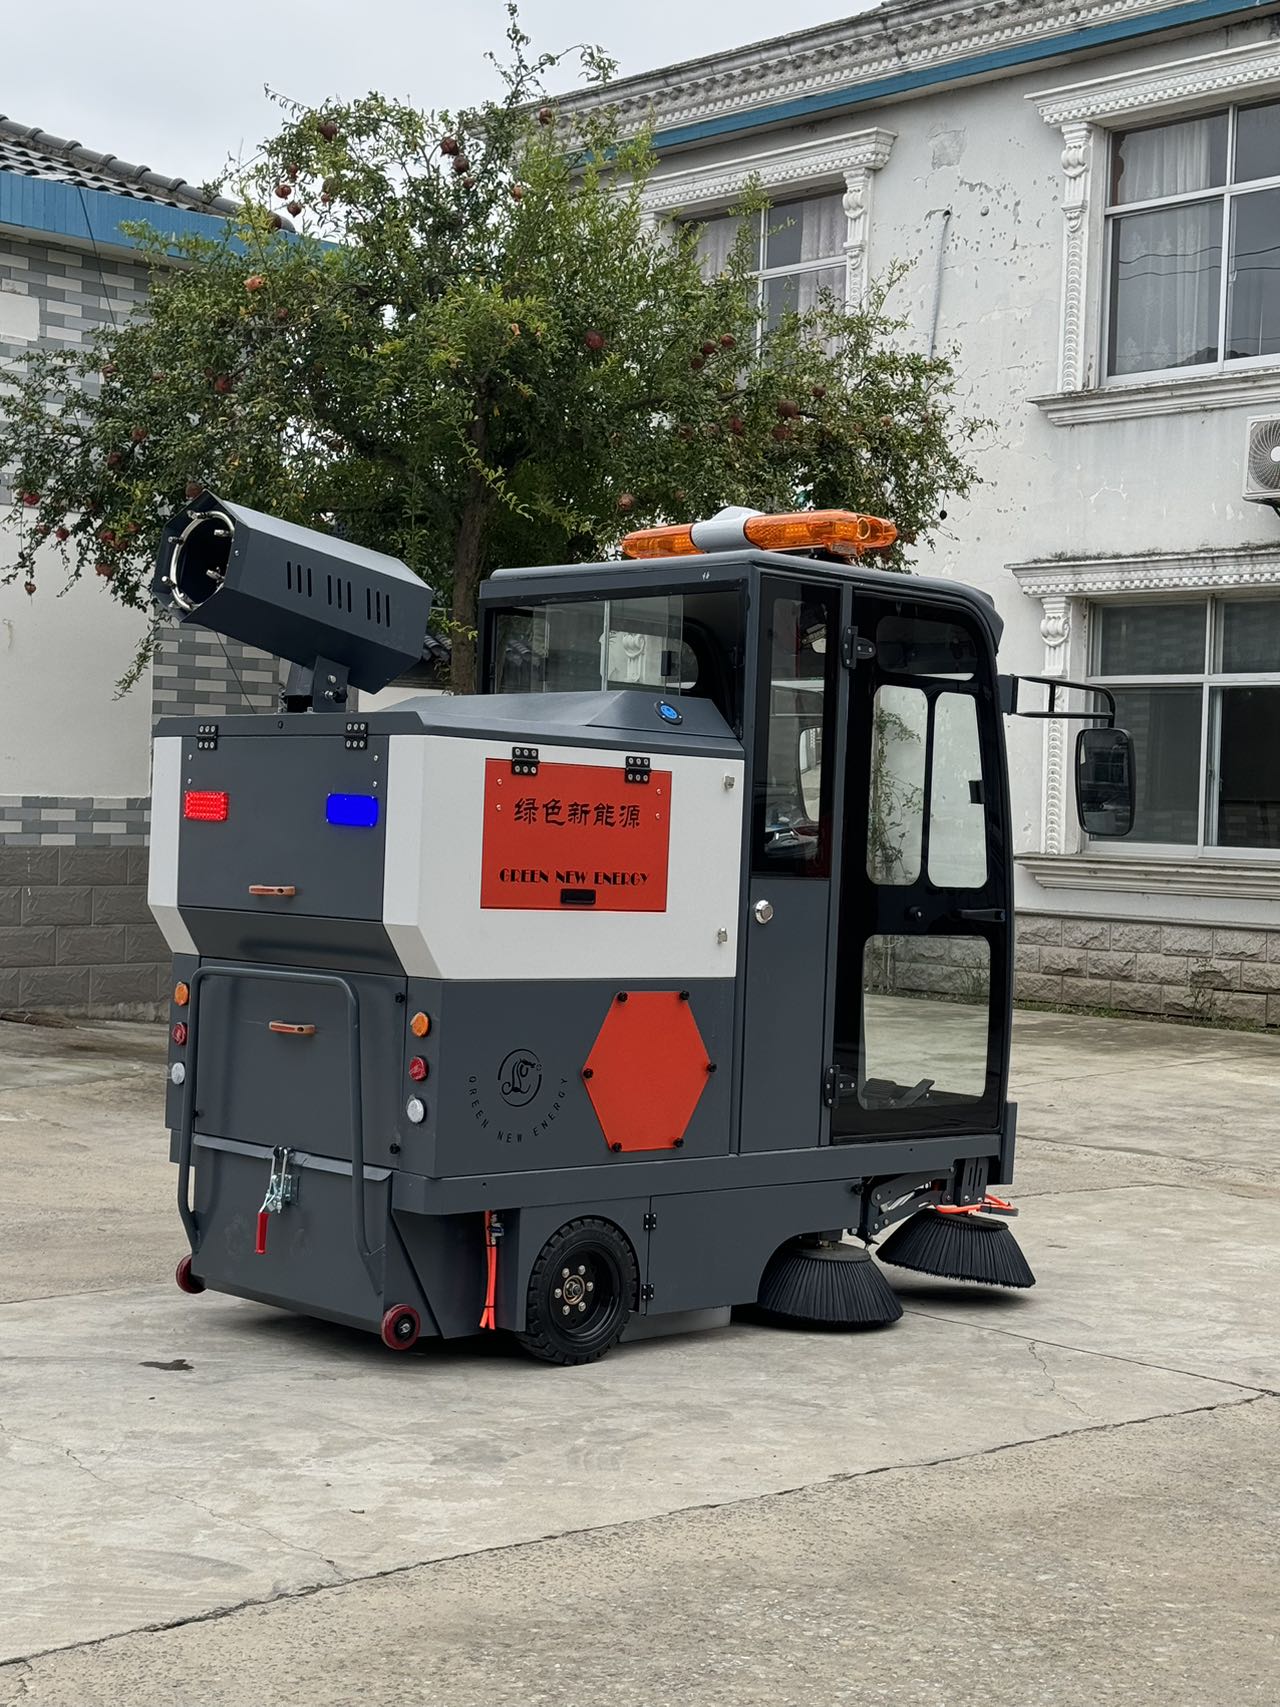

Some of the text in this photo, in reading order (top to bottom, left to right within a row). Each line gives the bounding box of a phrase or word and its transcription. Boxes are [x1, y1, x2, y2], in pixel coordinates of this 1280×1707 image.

[513, 797, 641, 829] 绿色新能源
[499, 868, 651, 886] GREEN NEW ENERGY
[468, 1076, 568, 1143] GREEN NEW ENERGY
